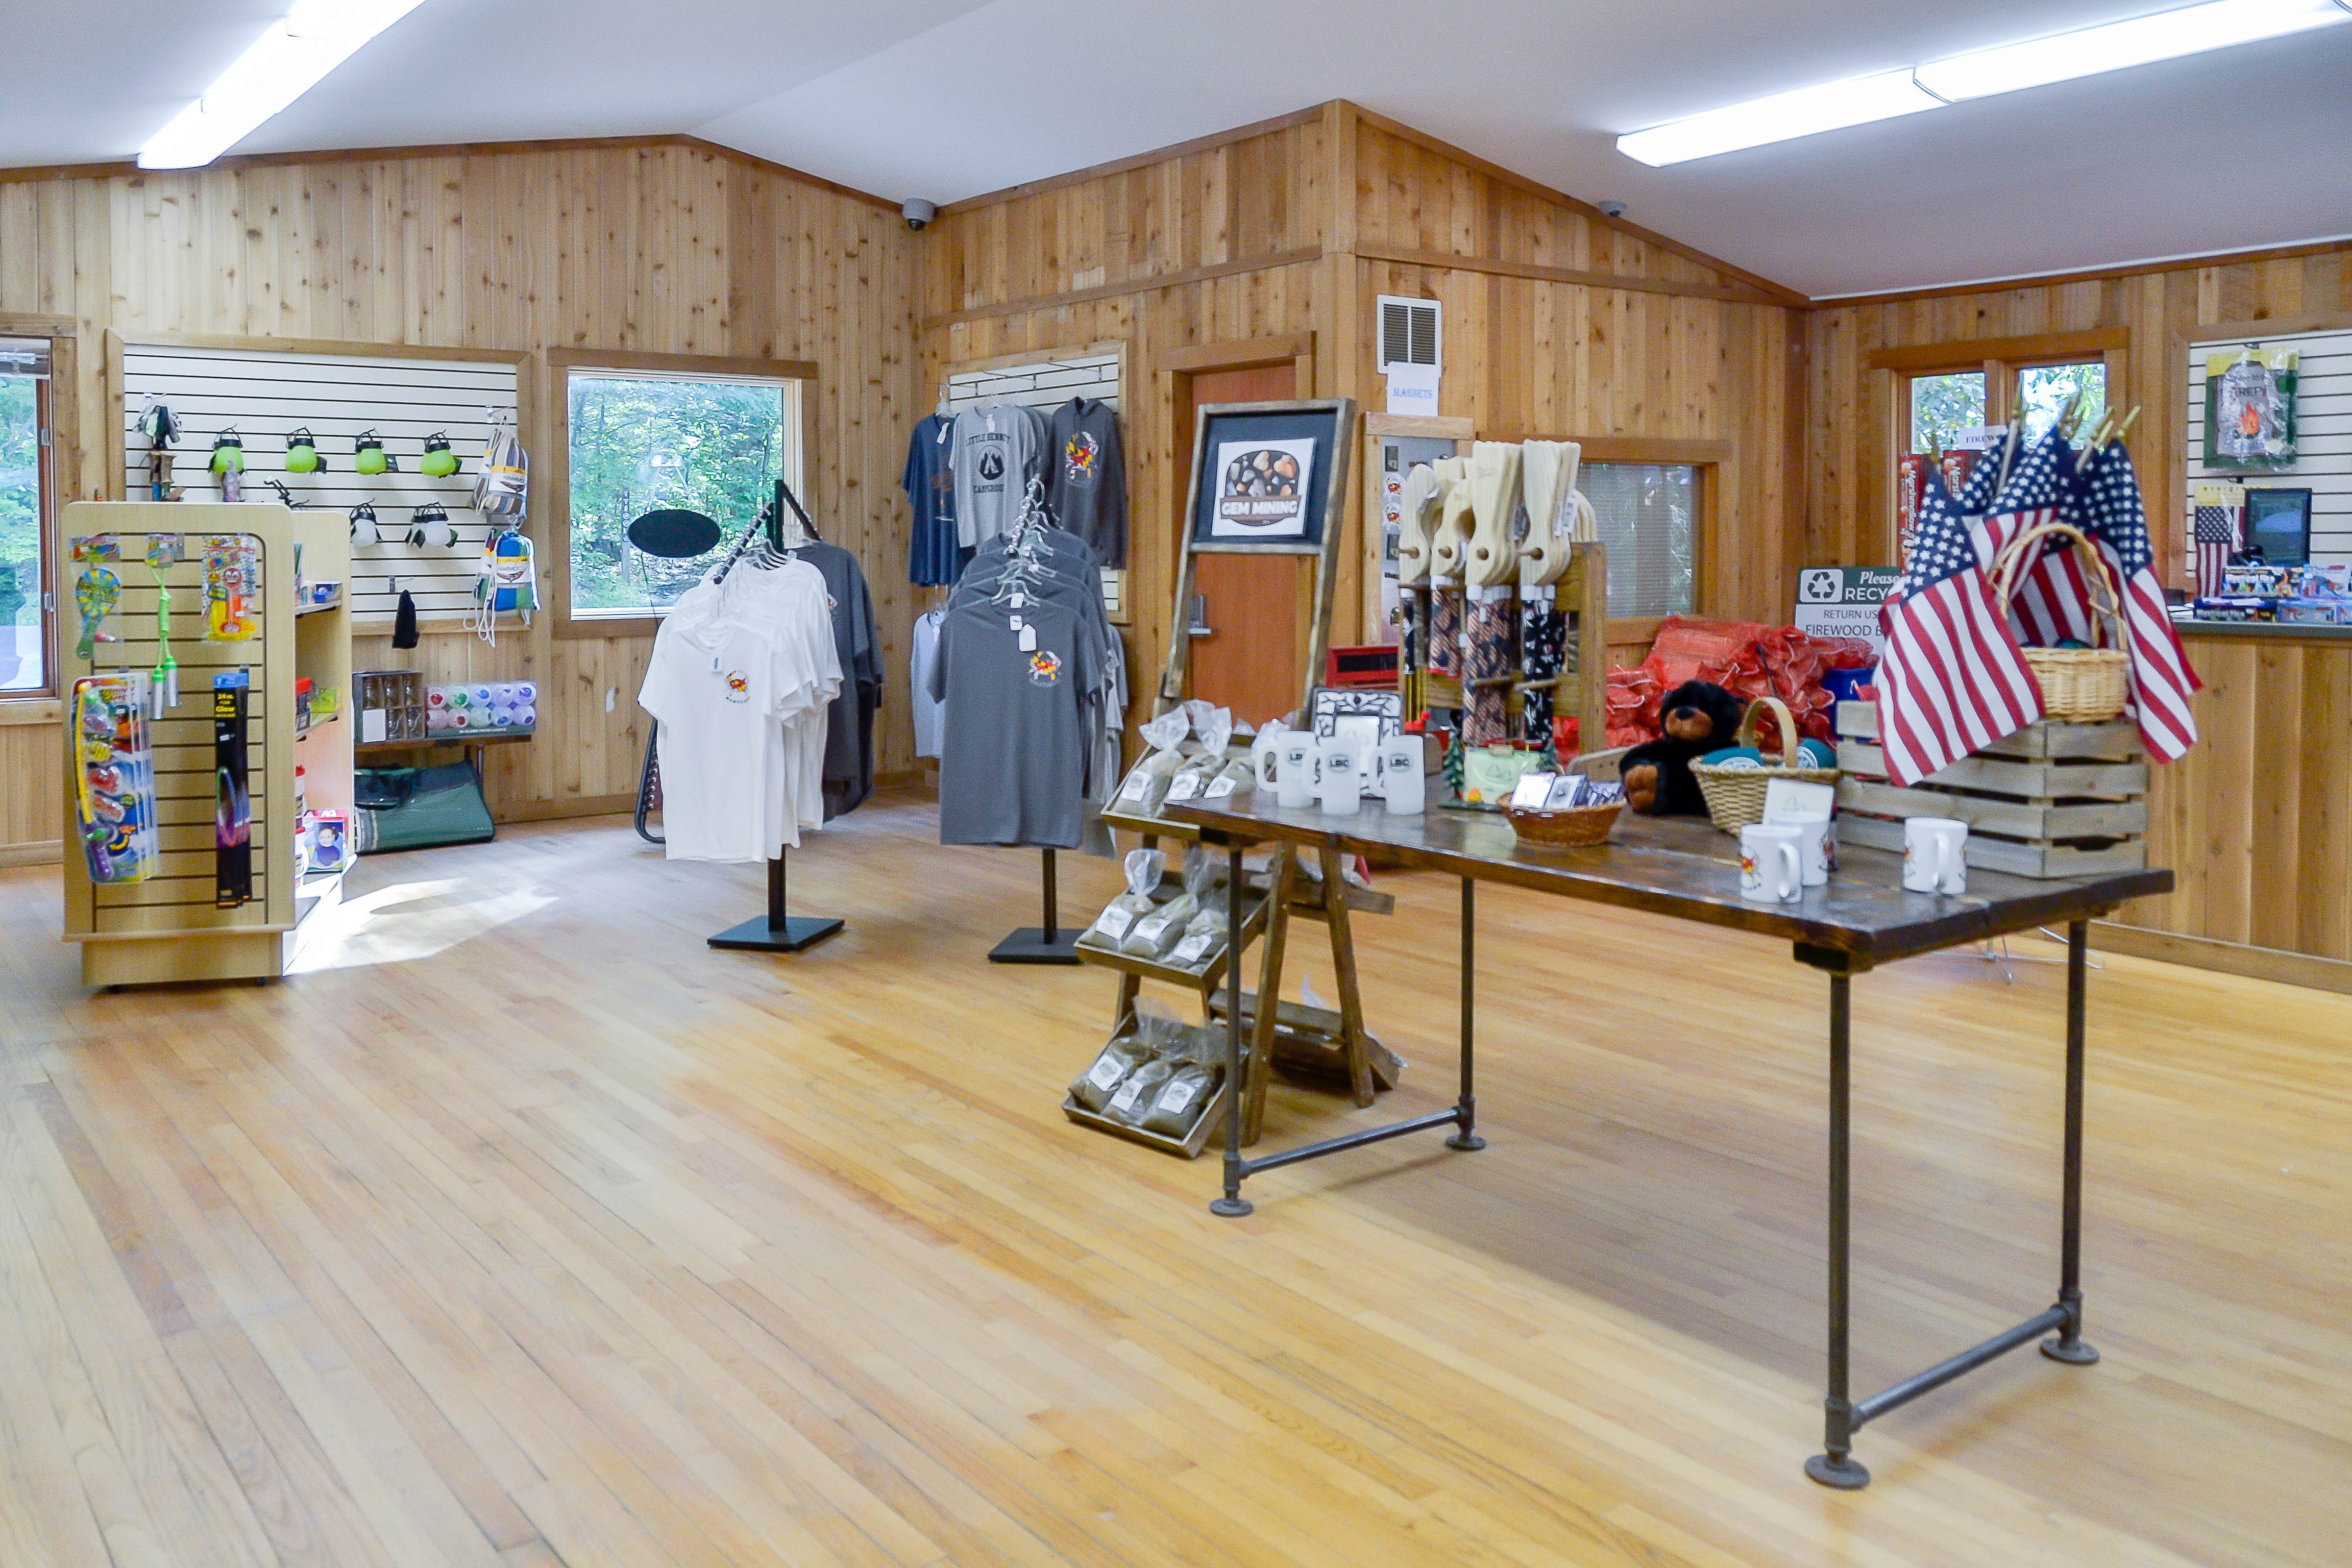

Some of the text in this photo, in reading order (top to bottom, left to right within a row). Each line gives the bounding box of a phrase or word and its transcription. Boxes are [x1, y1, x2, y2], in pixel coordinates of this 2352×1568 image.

[1392, 387, 1433, 398] MAGNETS
[1966, 434, 1999, 443] FIREW
[1221, 500, 1297, 516] GEM MINING
[1859, 571, 1900, 584] Please
[1845, 588, 1888, 601] RECY
[1824, 609, 1879, 619] RETURN US
[1806, 624, 1872, 636] FIREWOOD
[1290, 752, 1303, 761] LB
